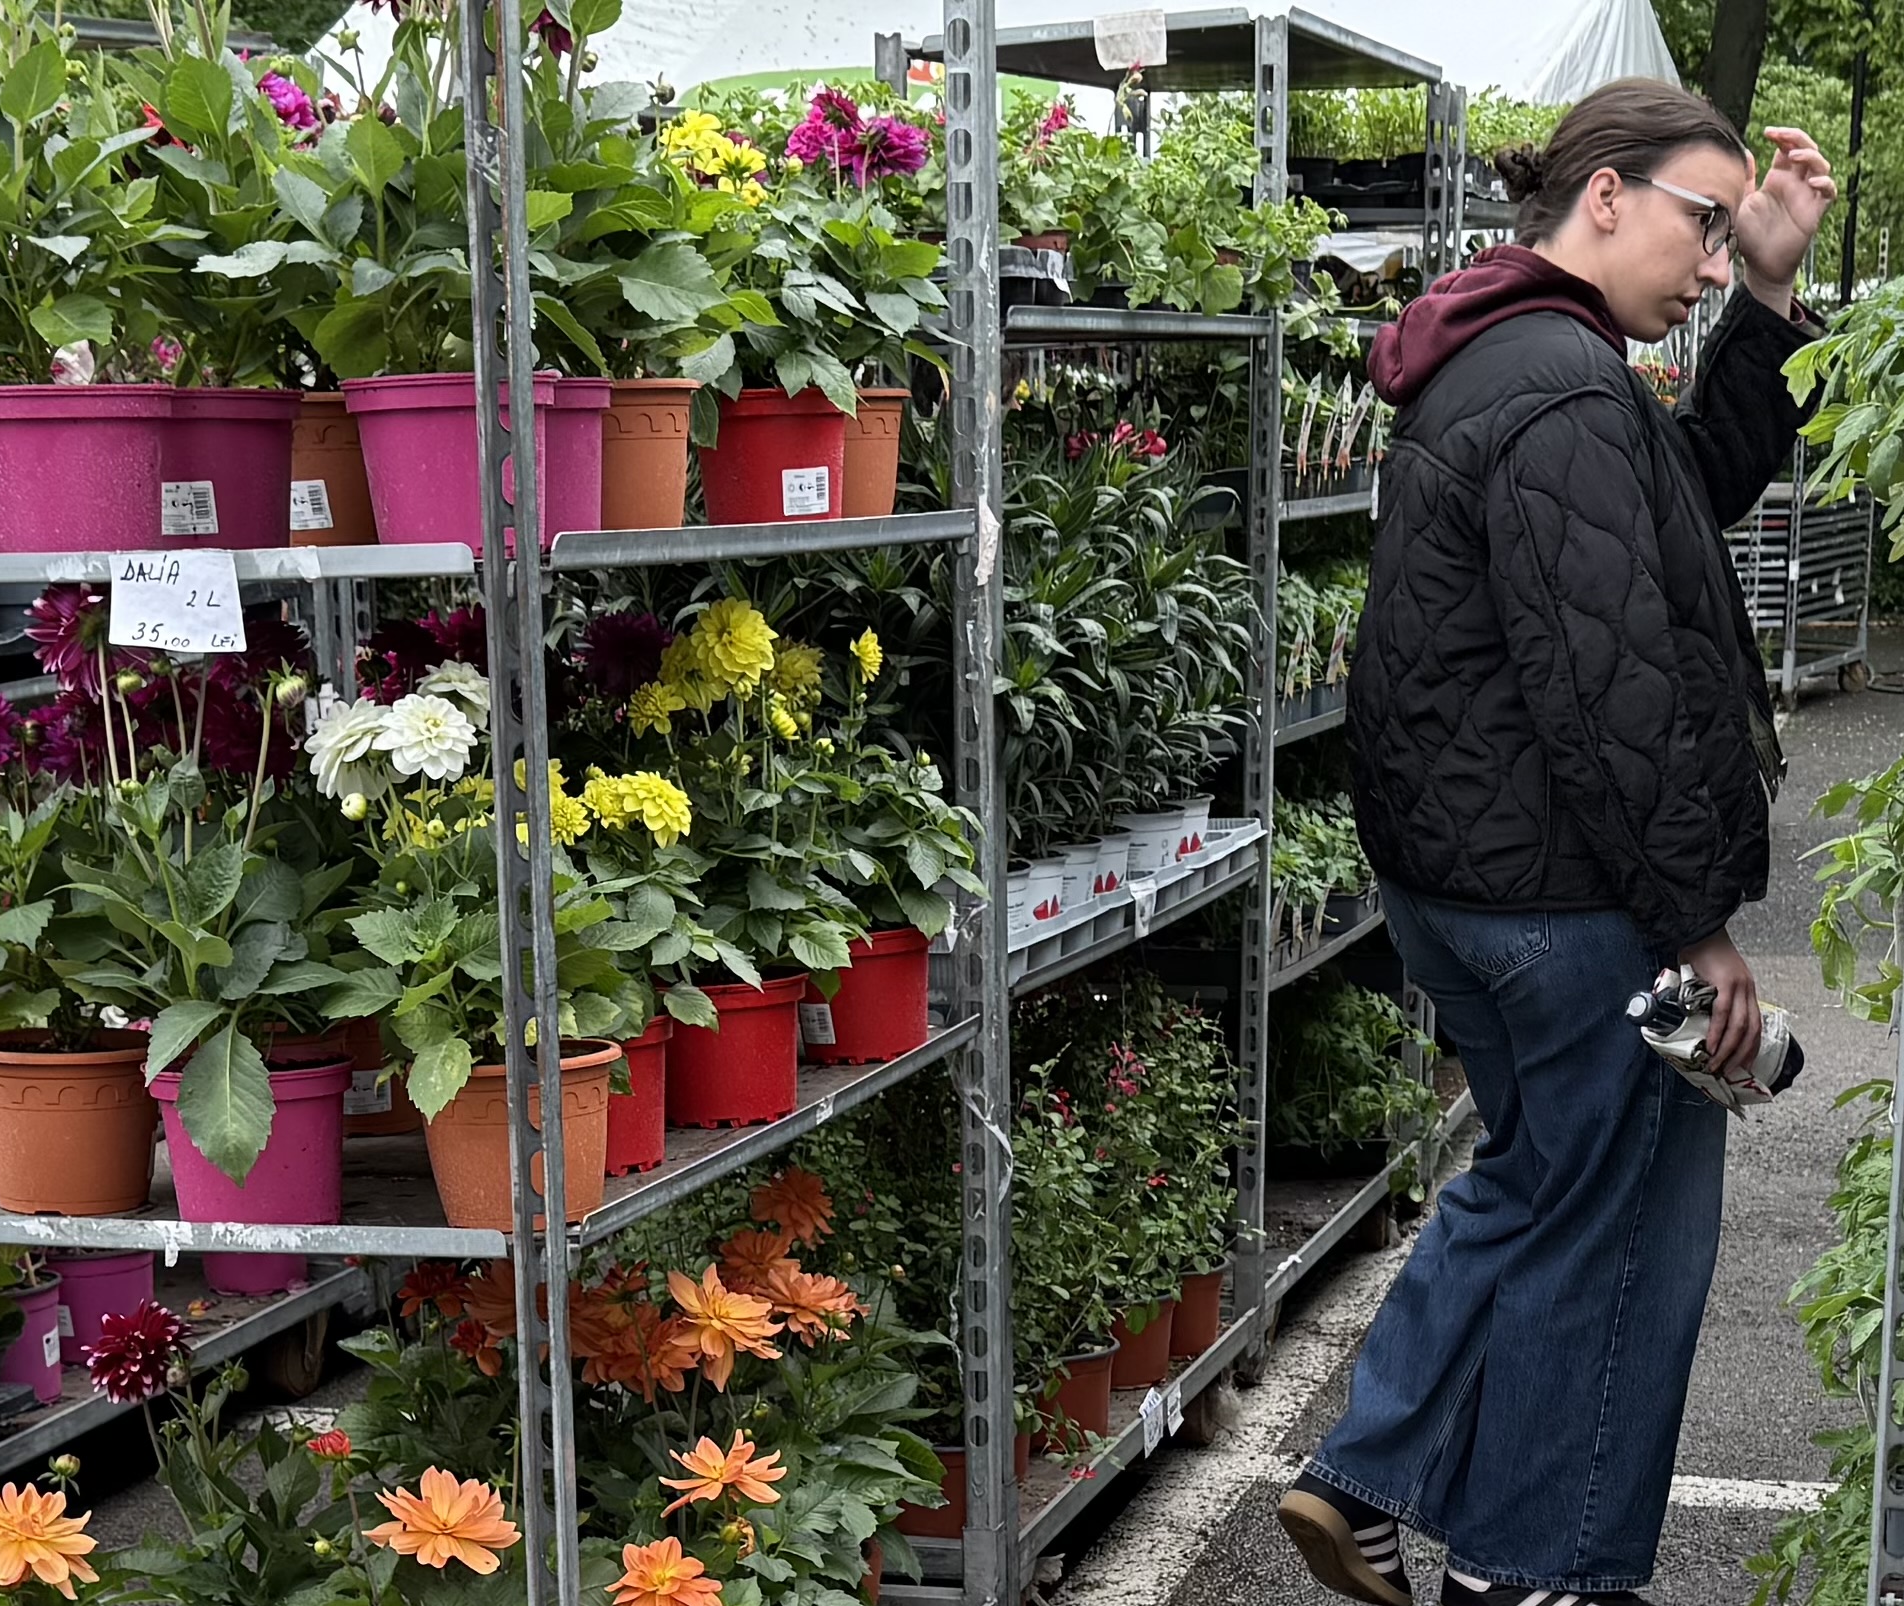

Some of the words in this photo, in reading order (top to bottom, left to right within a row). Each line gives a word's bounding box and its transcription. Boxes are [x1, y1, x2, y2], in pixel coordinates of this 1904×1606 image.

[186, 590, 197, 608] 2
[207, 590, 221, 607] L
[132, 622, 191, 648] 35,00
